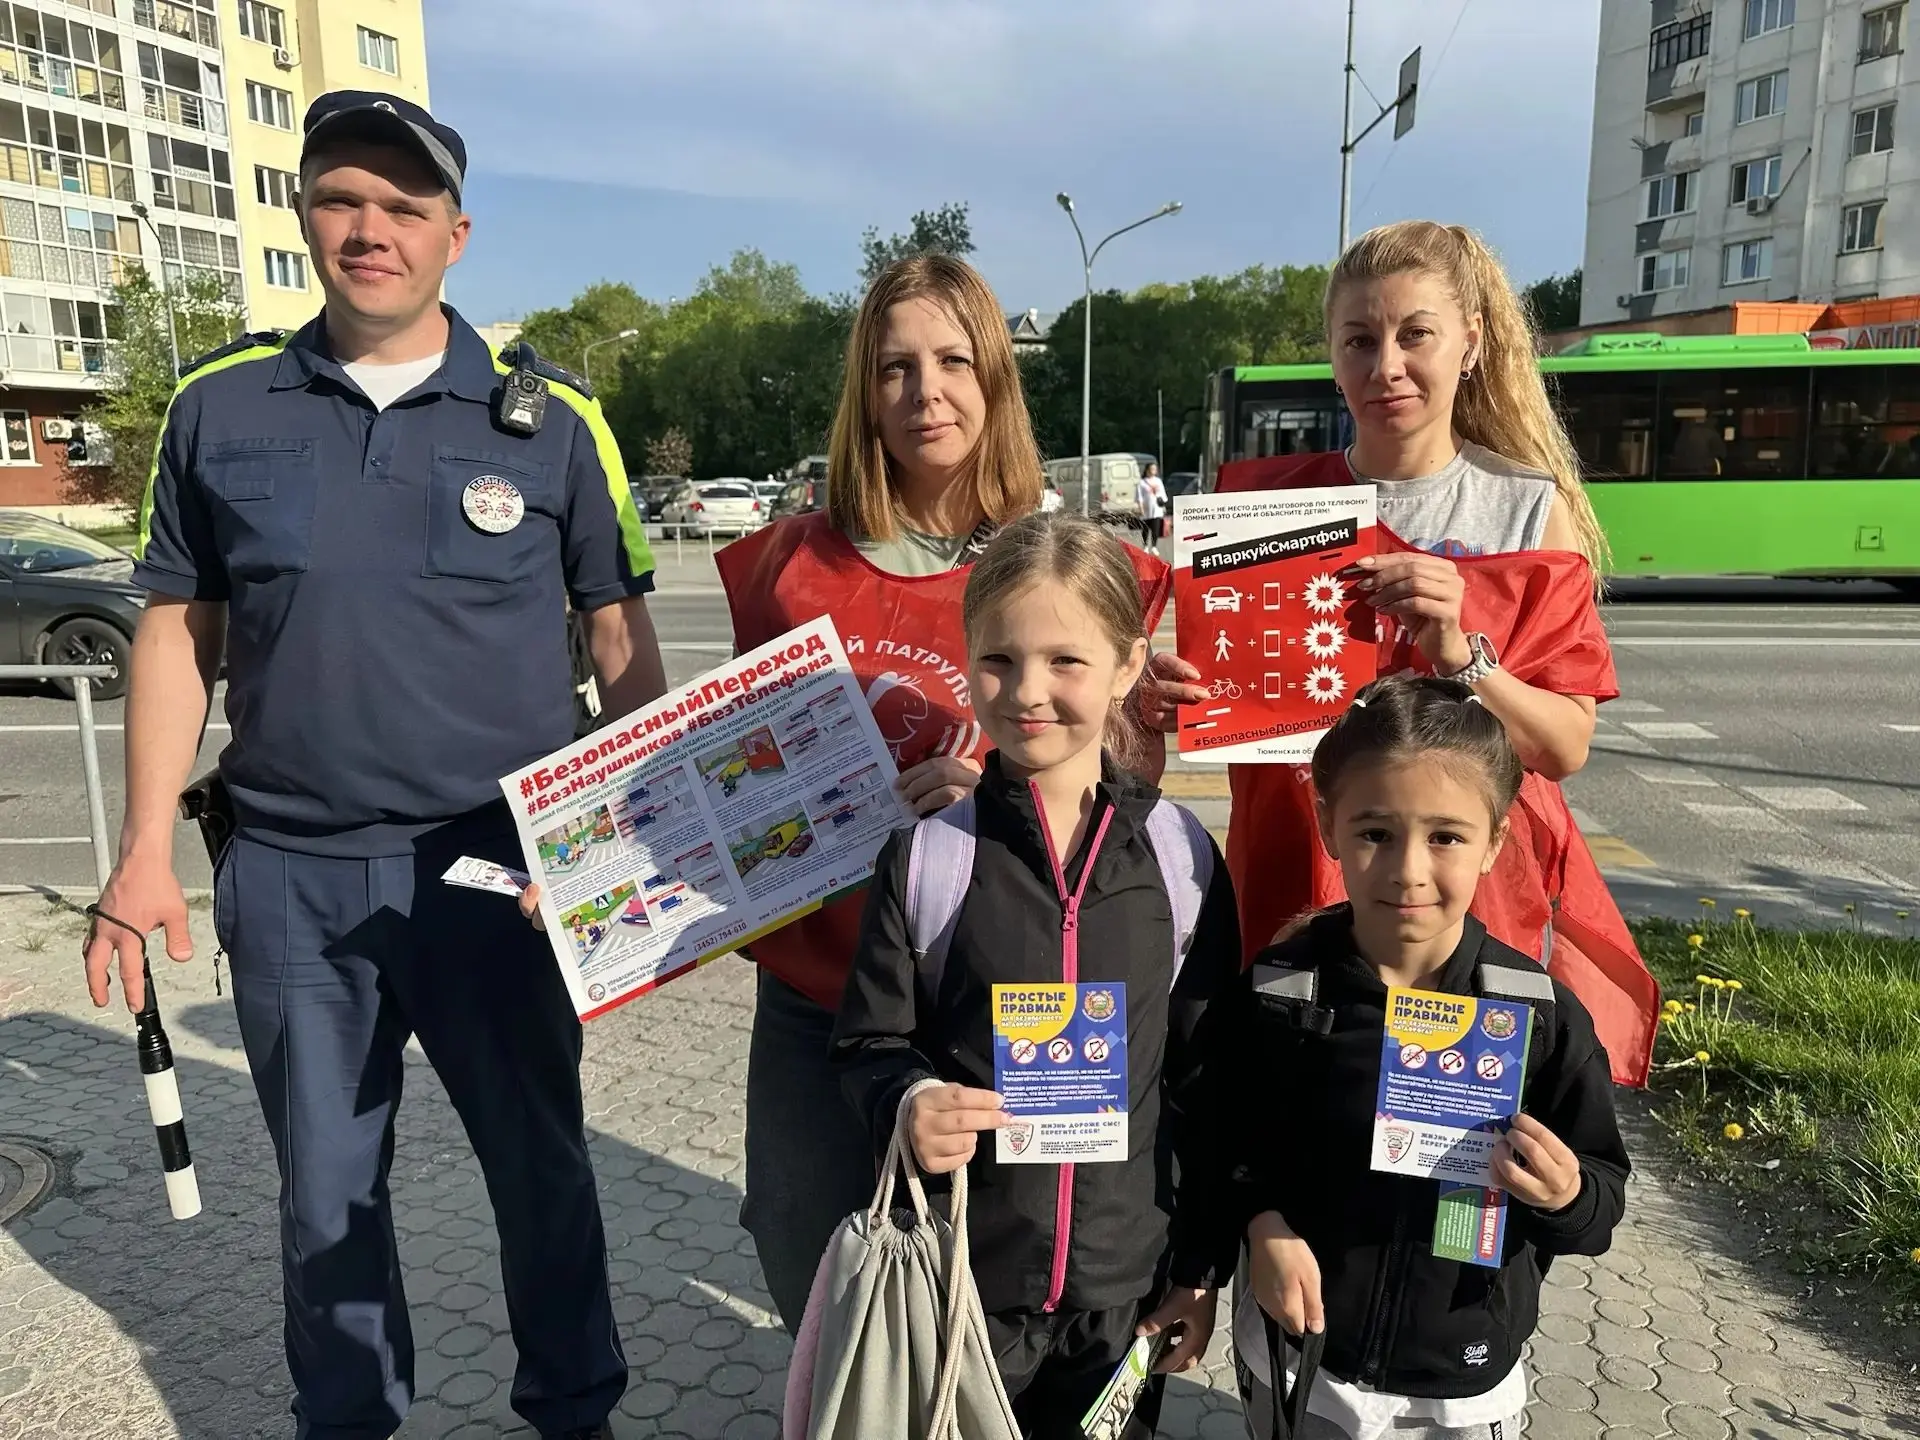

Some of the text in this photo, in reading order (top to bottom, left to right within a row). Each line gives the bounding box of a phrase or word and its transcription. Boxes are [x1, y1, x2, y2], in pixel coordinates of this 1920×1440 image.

[470, 477, 519, 498] ПОЛИЦИЯ
[1182, 507, 1209, 516] ДОРОГА
[1269, 502, 1314, 510] РАЗГОВОРОВ
[1327, 498, 1368, 507] ТЕЛЕФОНУ!
[1200, 526, 1350, 569] #ПаркуйСмартфон
[875, 639, 971, 708] ПАТРУЛЬ
[519, 633, 827, 799] #БезопасныйПереход
[527, 728, 684, 817] #БезНаушников
[687, 653, 834, 733] #БезТелефона
[555, 797, 580, 813] ПЕРЕХОД
[609, 760, 651, 785] ПЕШЕХОДНОМУ
[715, 724, 726, 733] ЧТО
[727, 709, 756, 728] ВОДИТЕЛИ
[756, 705, 765, 713] ВО
[765, 698, 780, 709] ВСЕХ
[779, 684, 805, 701] ПОЛОСАХ
[804, 668, 837, 688] ДВИЖЕНИЯ
[639, 765, 660, 779] ВРЕМЯ
[659, 751, 688, 769] ПЕРЕХОДА
[688, 731, 730, 755] ВНИМАТЕЛЬНО
[730, 716, 760, 735] СМОТРИТЕ
[768, 700, 793, 716] ДОРОГУ!
[1000, 992, 1066, 1002] ПРОСТЫЕ
[1395, 995, 1464, 1013] ПРОСТЫЕ
[1000, 1004, 1061, 1013] ПРАВИЛА
[1394, 1006, 1458, 1024] ПРАВИЛА
[1450, 1137, 1483, 1146] ДОРОЖЕ
